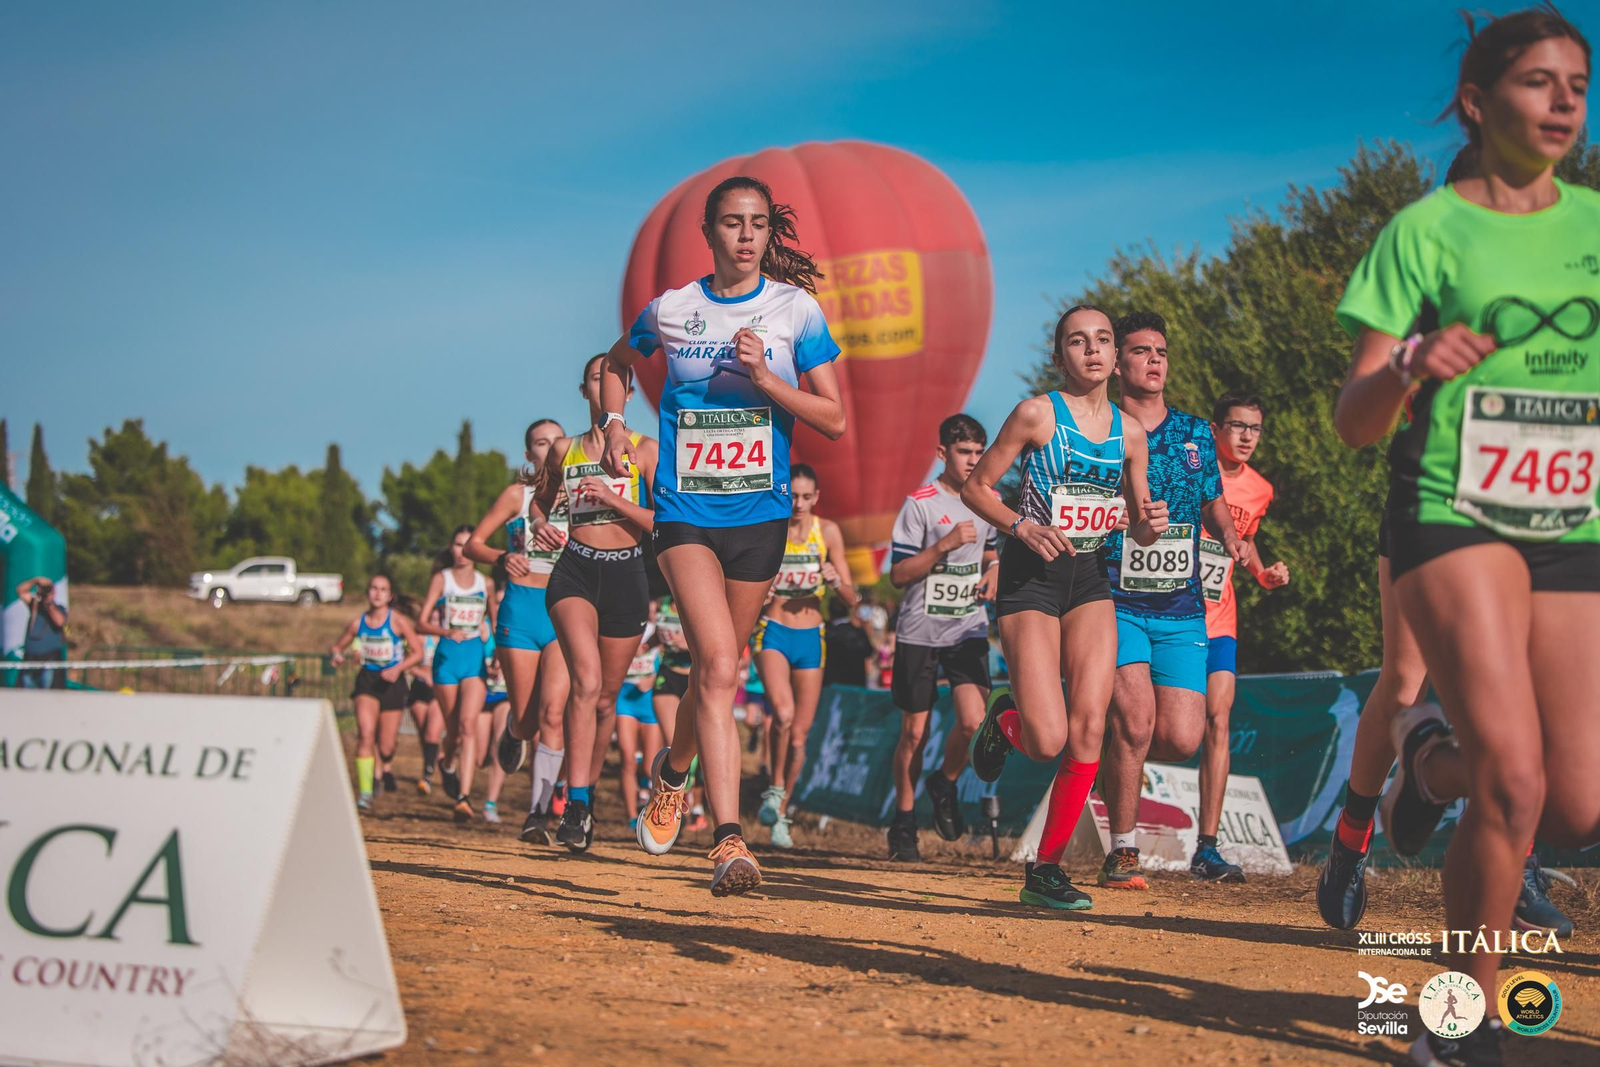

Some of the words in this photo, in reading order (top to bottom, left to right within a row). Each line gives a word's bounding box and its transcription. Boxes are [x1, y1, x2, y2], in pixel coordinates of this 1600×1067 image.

[677, 346, 773, 361] MARACA
[1525, 350, 1588, 369] Infinity
[702, 412, 747, 424] ITÁLICA
[686, 440, 766, 470] 7424
[1478, 445, 1594, 494] 7463
[1059, 506, 1119, 531] 5506
[593, 550, 631, 561] PRO
[1129, 550, 1189, 572] 8089
[1200, 561, 1225, 585] 73
[194, 746, 256, 780] DE
[12, 955, 195, 997] COUNTRY
